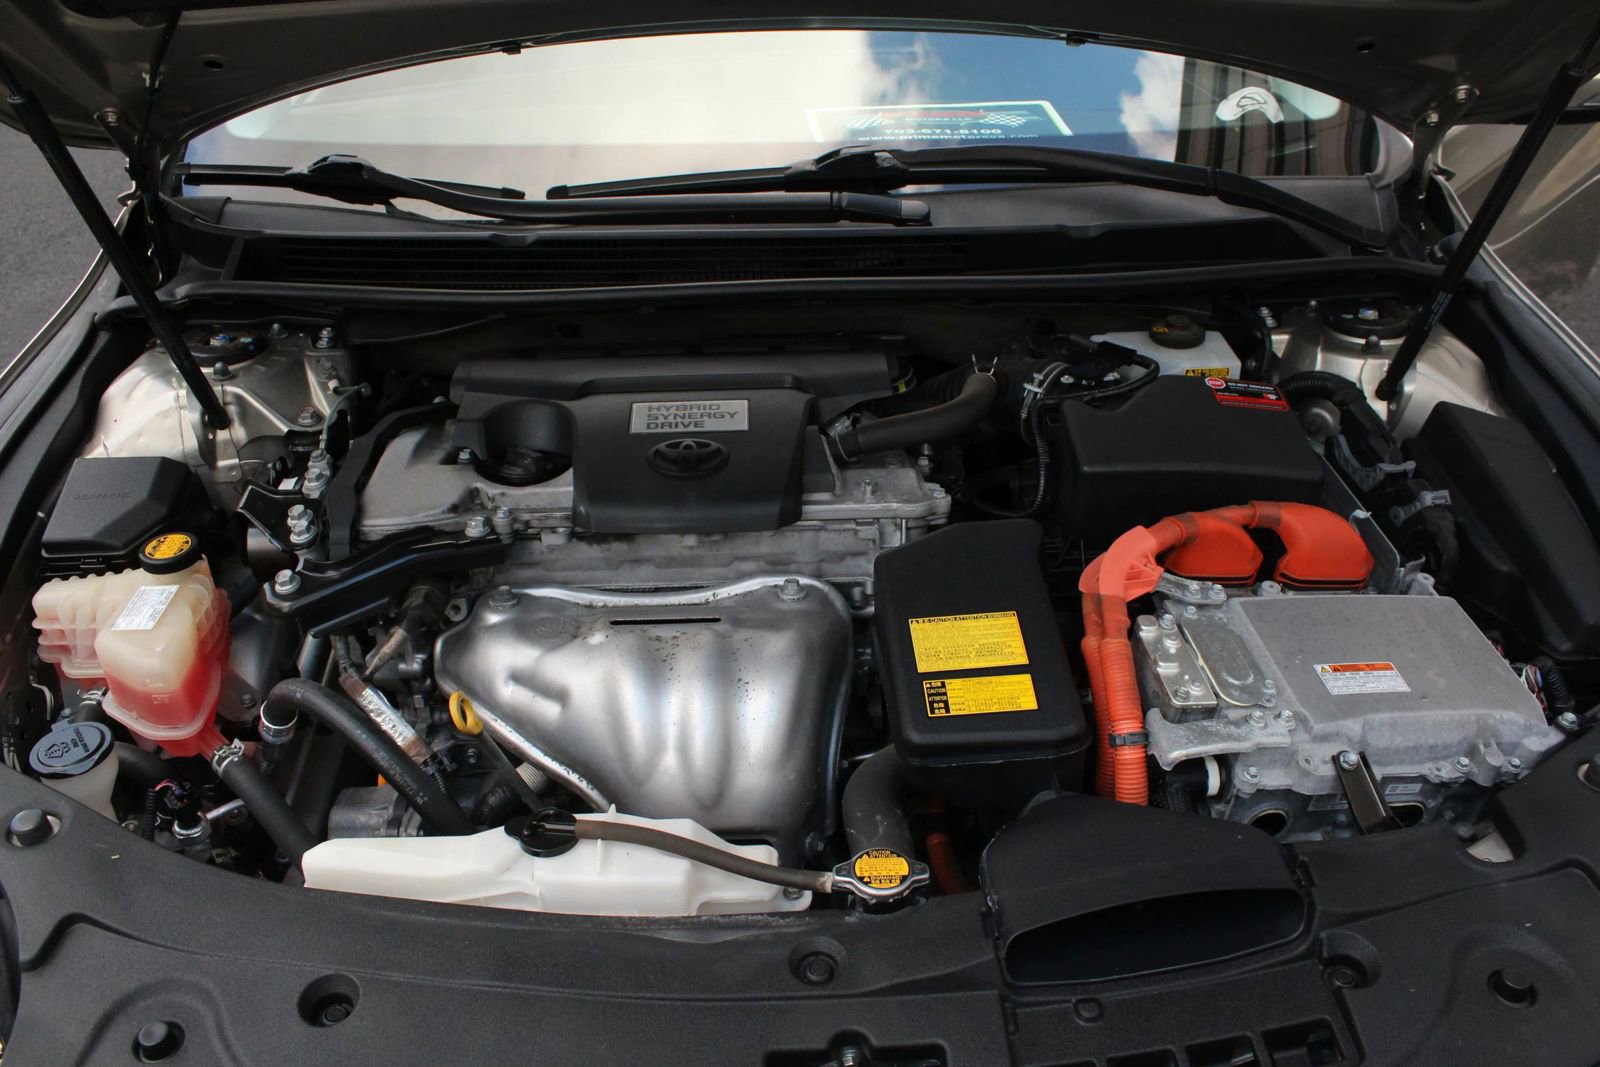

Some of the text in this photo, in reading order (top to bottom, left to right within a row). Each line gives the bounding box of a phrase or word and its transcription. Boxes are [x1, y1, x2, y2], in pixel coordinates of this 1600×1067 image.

[647, 403, 721, 413] HYBRID
[647, 411, 739, 421] SYNERGY
[646, 420, 706, 430] DRIVE
[930, 616, 955, 624] CAUTION
